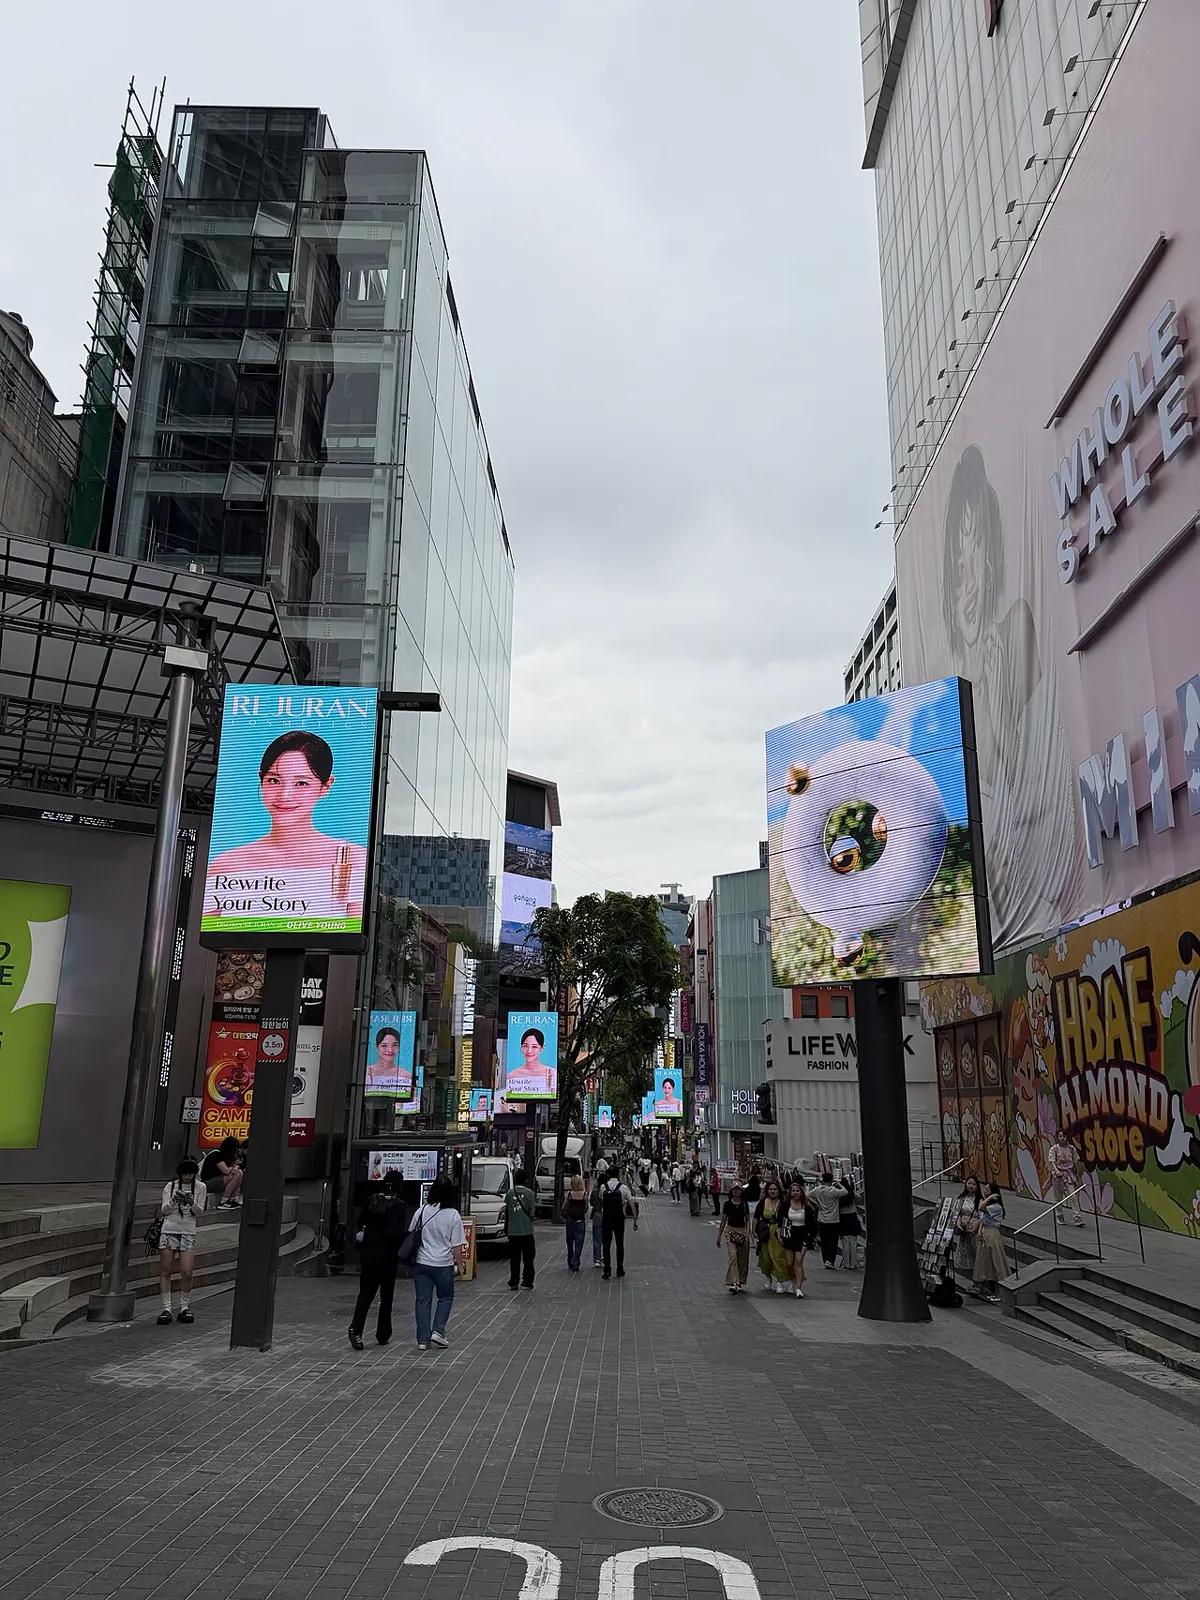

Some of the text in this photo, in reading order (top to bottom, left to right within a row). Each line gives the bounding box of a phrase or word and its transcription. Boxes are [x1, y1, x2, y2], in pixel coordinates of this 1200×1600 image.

[1050, 299, 1186, 520] WHOLE
[1057, 374, 1194, 585] SALE
[214, 875, 286, 891] Rewrite
[213, 895, 311, 915] Your Story
[1055, 953, 1151, 1075] HBAF
[264, 1041, 283, 1049] 3.5m
[807, 1060, 849, 1070] FASHION
[1058, 1066, 1169, 1133] ALMOND
[203, 1127, 250, 1138] CENTE
[1083, 1124, 1144, 1163] store
